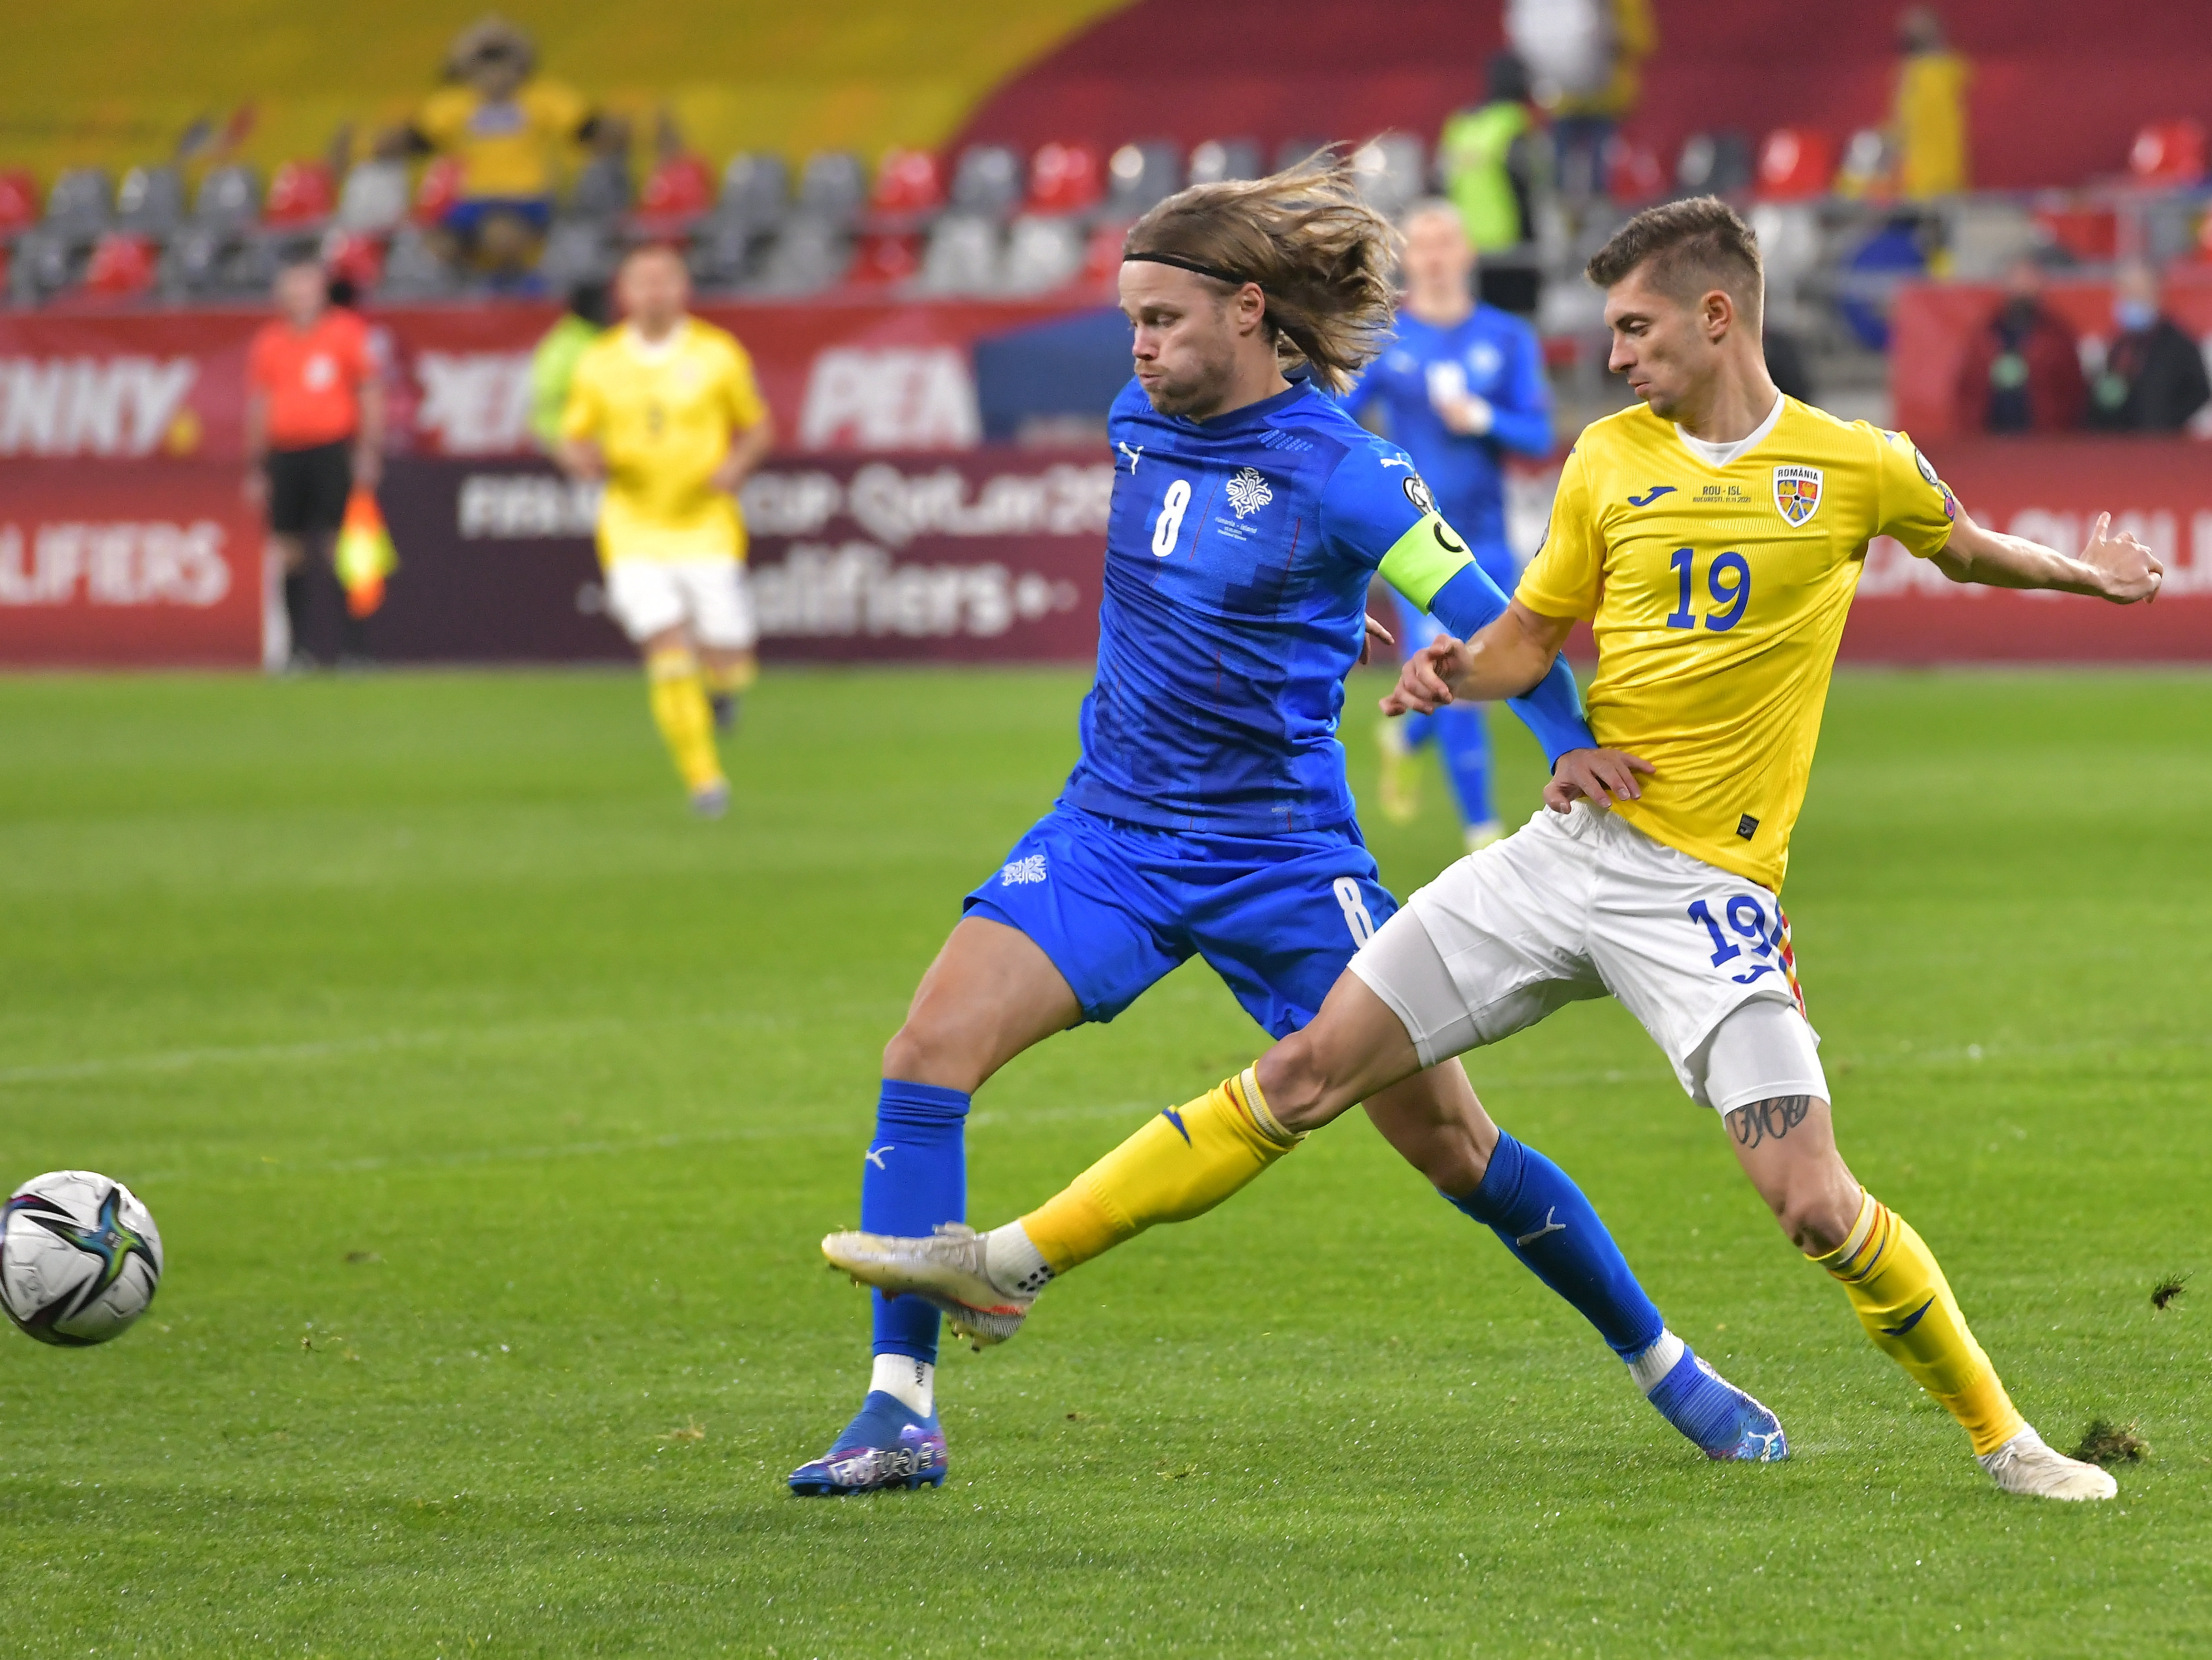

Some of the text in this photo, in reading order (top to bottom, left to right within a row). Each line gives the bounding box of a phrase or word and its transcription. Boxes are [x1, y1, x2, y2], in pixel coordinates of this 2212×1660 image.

[1703, 485, 1721, 495] ROU
[1728, 485, 1742, 495] ISL
[1777, 467, 1818, 481] ROMÂNIA
[1152, 479, 1192, 558] 8
[0, 519, 231, 608] LIFIERS
[1666, 548, 1751, 632] 19
[1333, 876, 1376, 949] 8
[1687, 895, 1773, 969] 19
